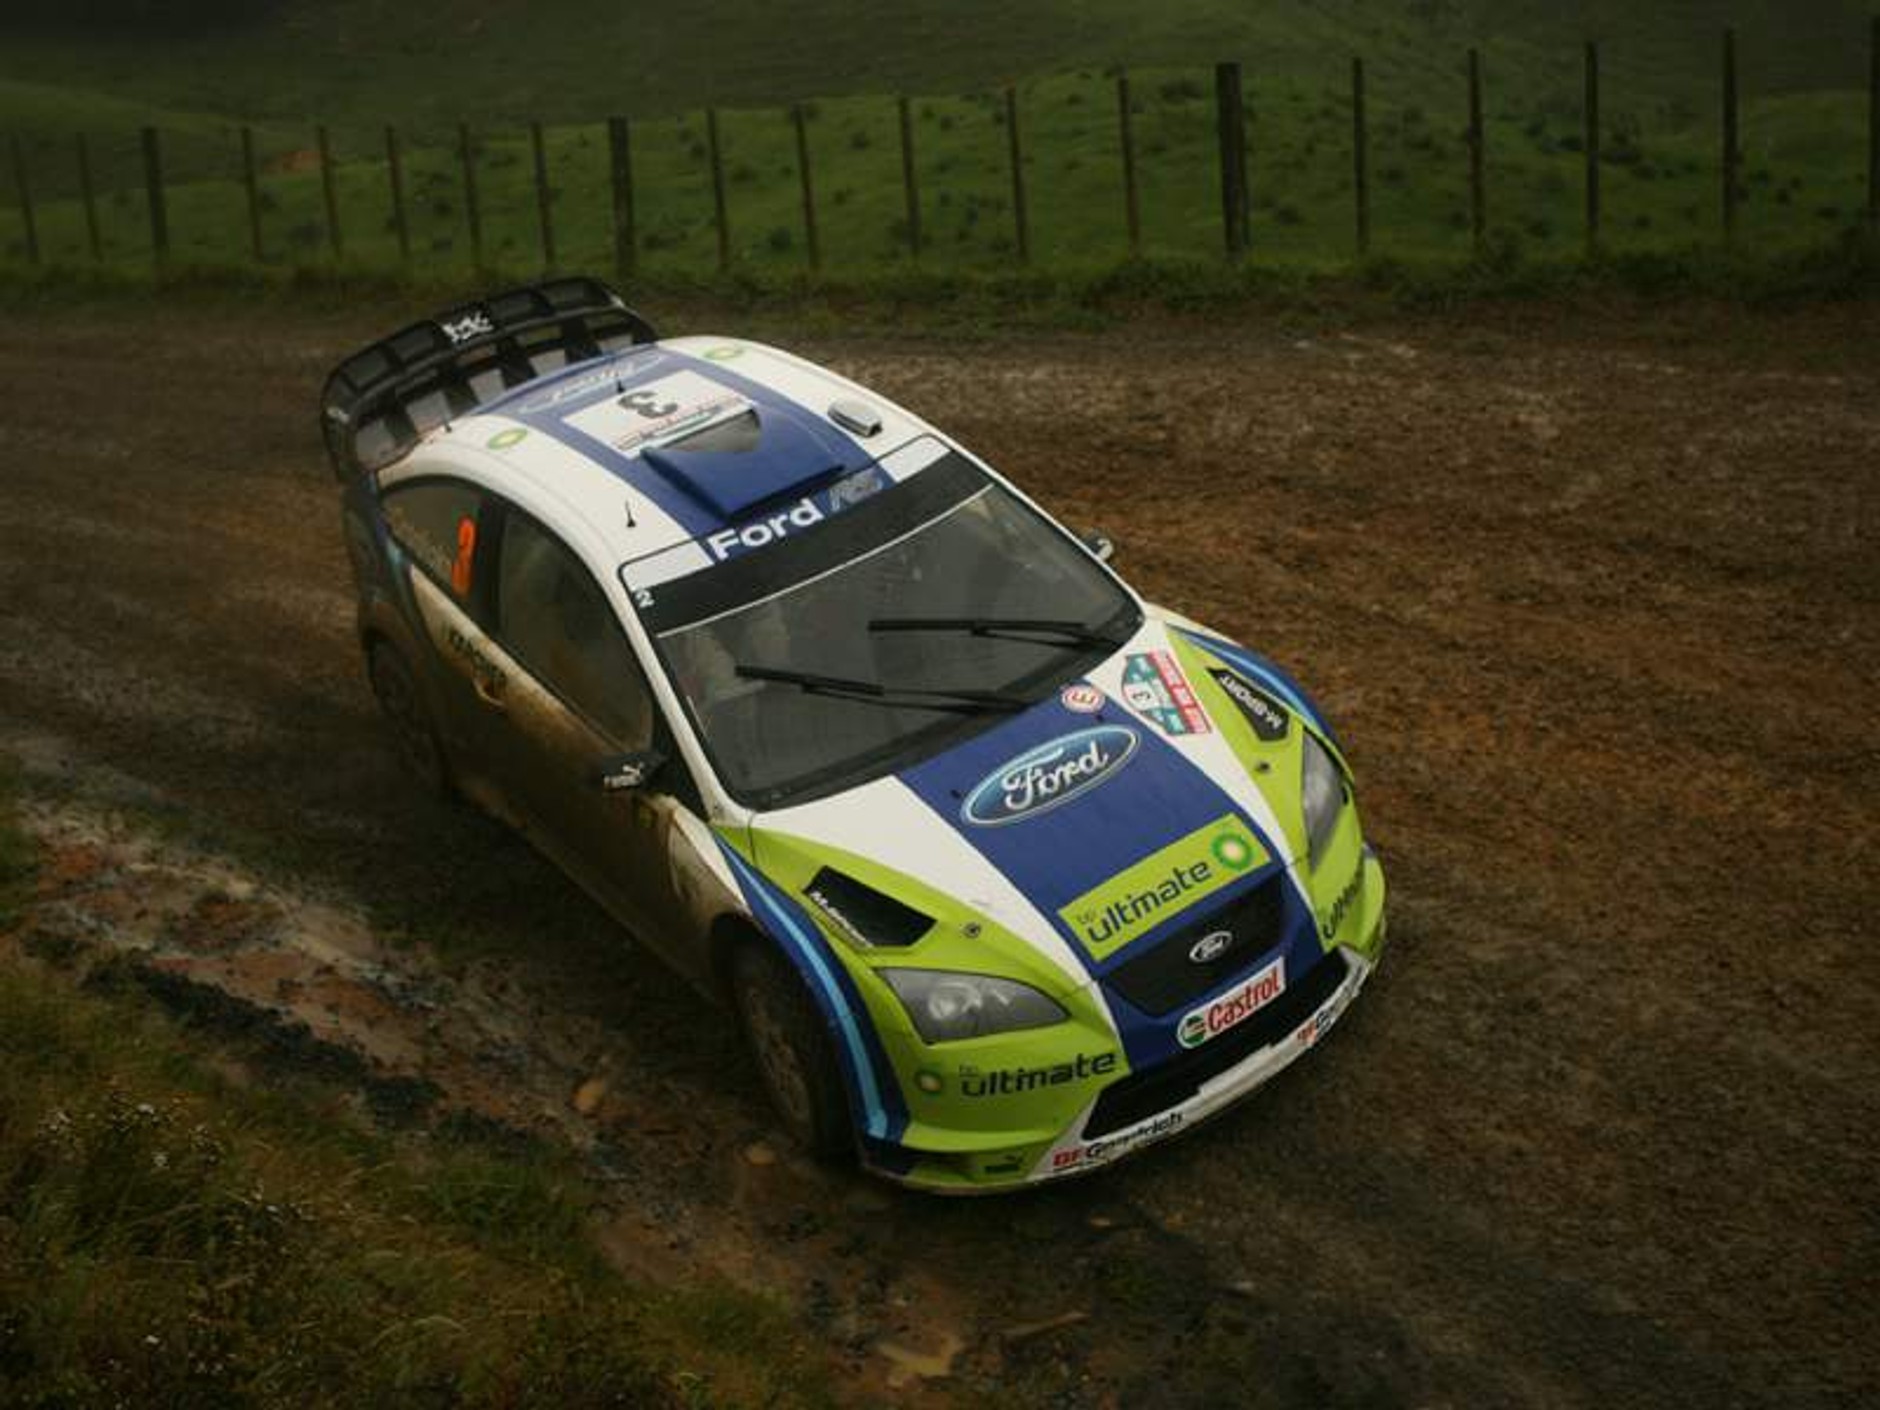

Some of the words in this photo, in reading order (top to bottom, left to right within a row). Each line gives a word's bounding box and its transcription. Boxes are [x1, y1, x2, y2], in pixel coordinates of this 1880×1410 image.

[617, 391, 678, 419] 3
[707, 498, 825, 560] Ford
[634, 589, 655, 608] 2
[1001, 739, 1110, 811] Ford
[1087, 860, 1213, 943] ultimate
[1208, 966, 1280, 1032] Castrol
[962, 1052, 1115, 1097] ultimate
